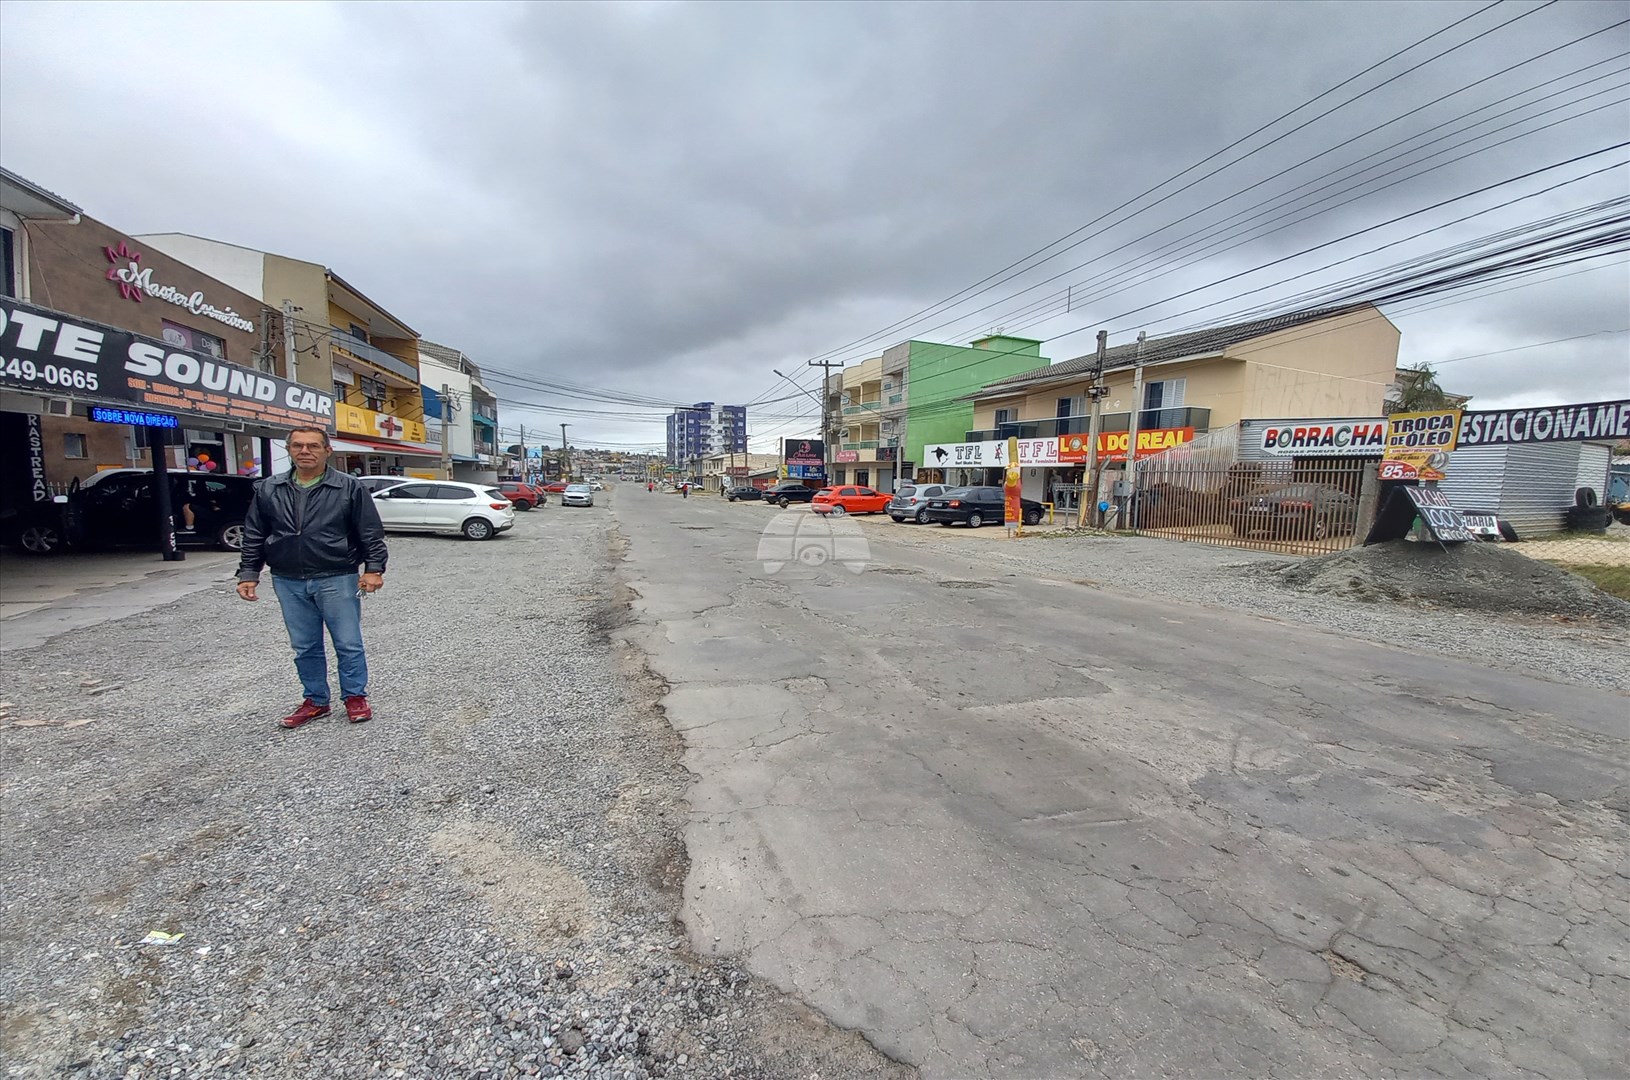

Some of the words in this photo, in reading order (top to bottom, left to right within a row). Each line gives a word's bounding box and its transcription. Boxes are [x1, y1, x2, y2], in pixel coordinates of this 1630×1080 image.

[0, 307, 104, 364] TE
[124, 342, 277, 402] SOUND
[285, 386, 333, 416] CAR
[96, 410, 122, 422] SOBRE
[124, 413, 144, 425] NOVA
[1391, 414, 1455, 434] TROCA
[1107, 434, 1130, 451] DO
[1137, 430, 1184, 450] REAL
[1264, 424, 1388, 449] BORRACHA
[1390, 436, 1405, 446] DE
[1405, 430, 1452, 447] ÓLEO
[955, 445, 982, 460] TFL
[1406, 487, 1450, 507] DUCHA
